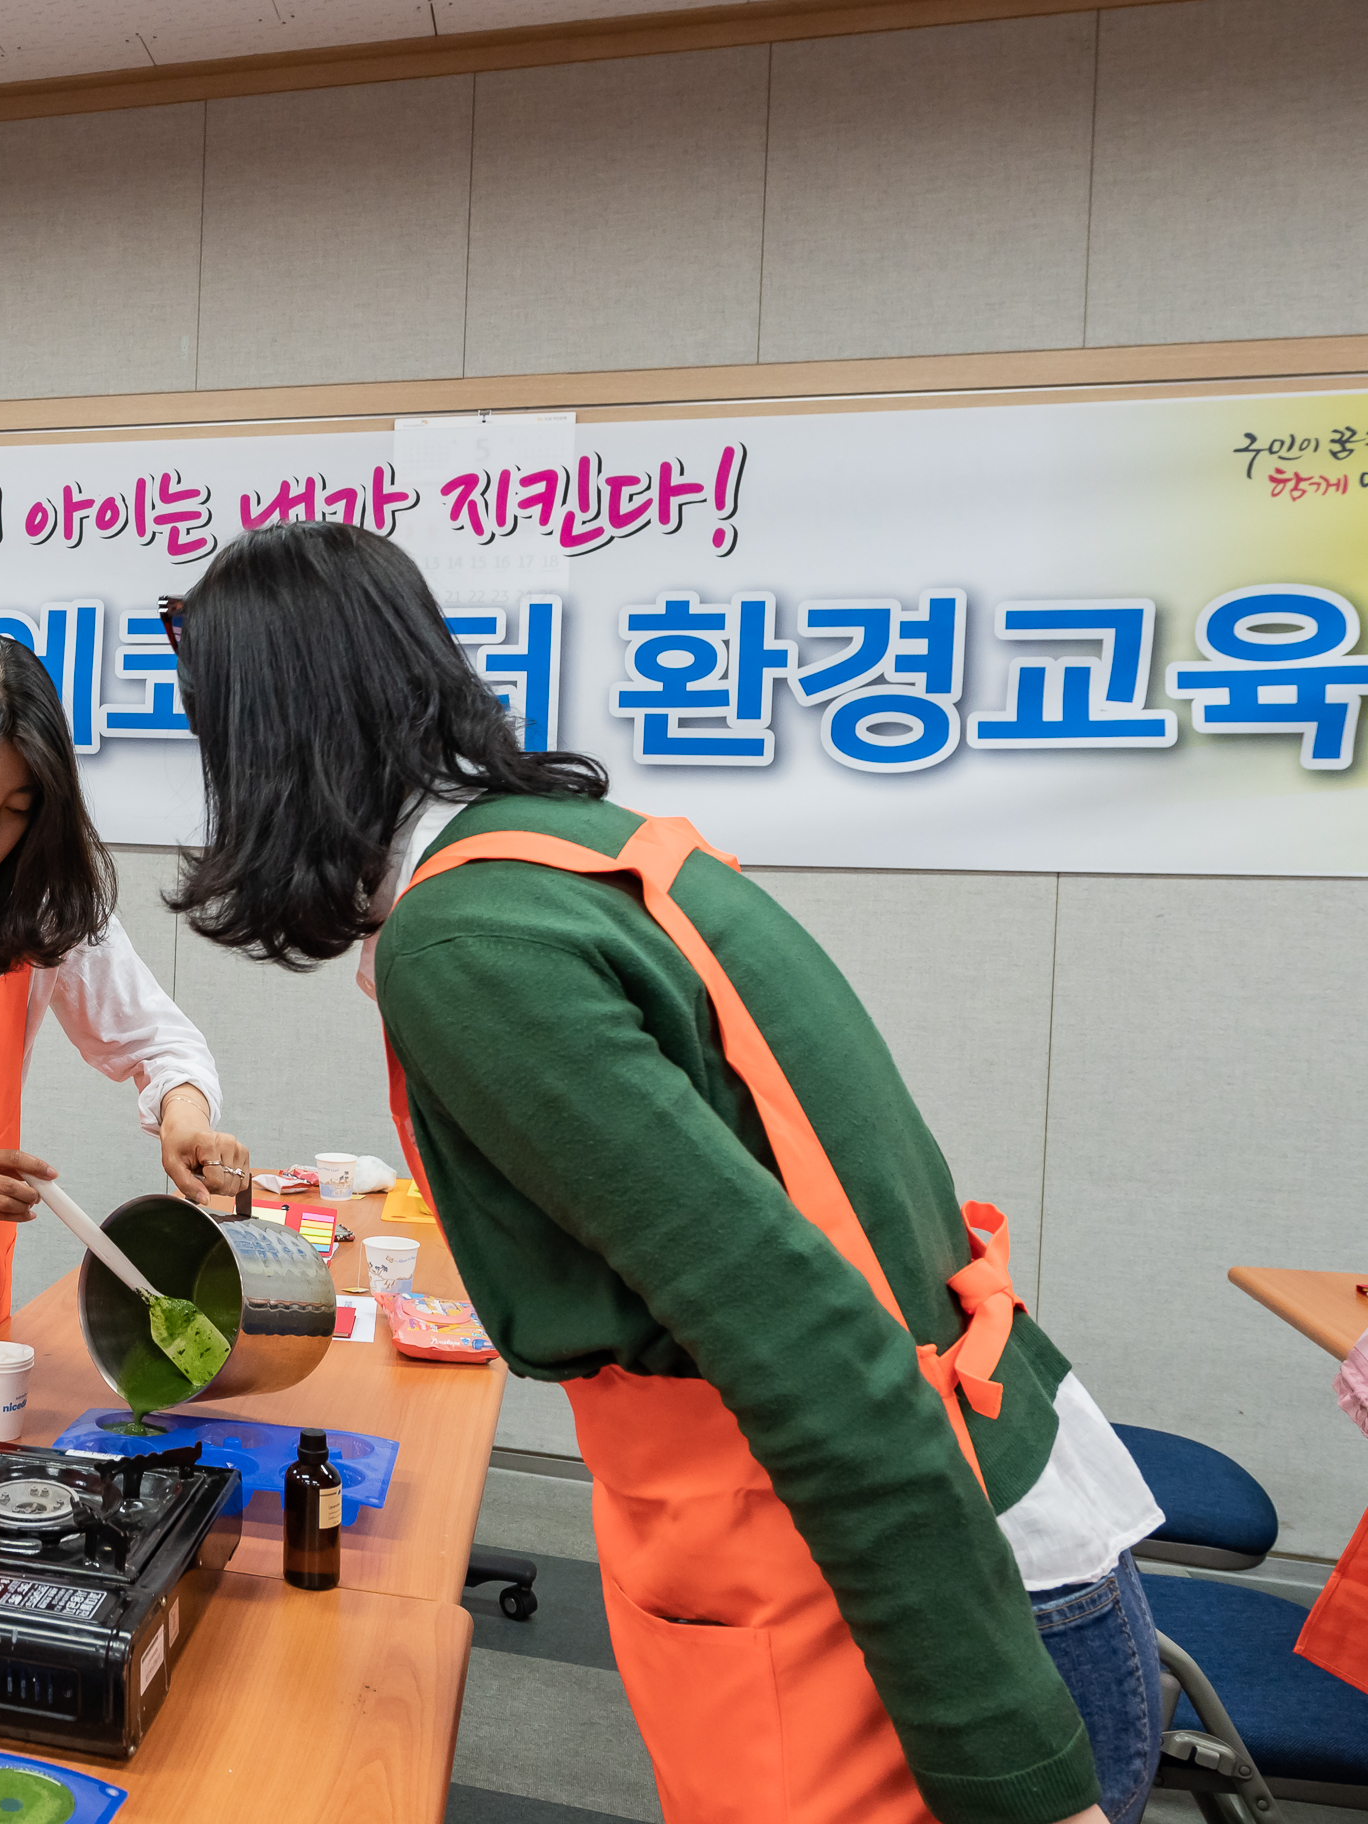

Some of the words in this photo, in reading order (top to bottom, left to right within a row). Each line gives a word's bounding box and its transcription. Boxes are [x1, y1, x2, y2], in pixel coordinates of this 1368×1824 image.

[1327, 425, 1368, 461] 꿈
[24, 471, 212, 560] 아이는
[239, 465, 412, 532] 내가
[439, 445, 740, 552] 지킨다!
[618, 592, 1368, 765] 환경교육
